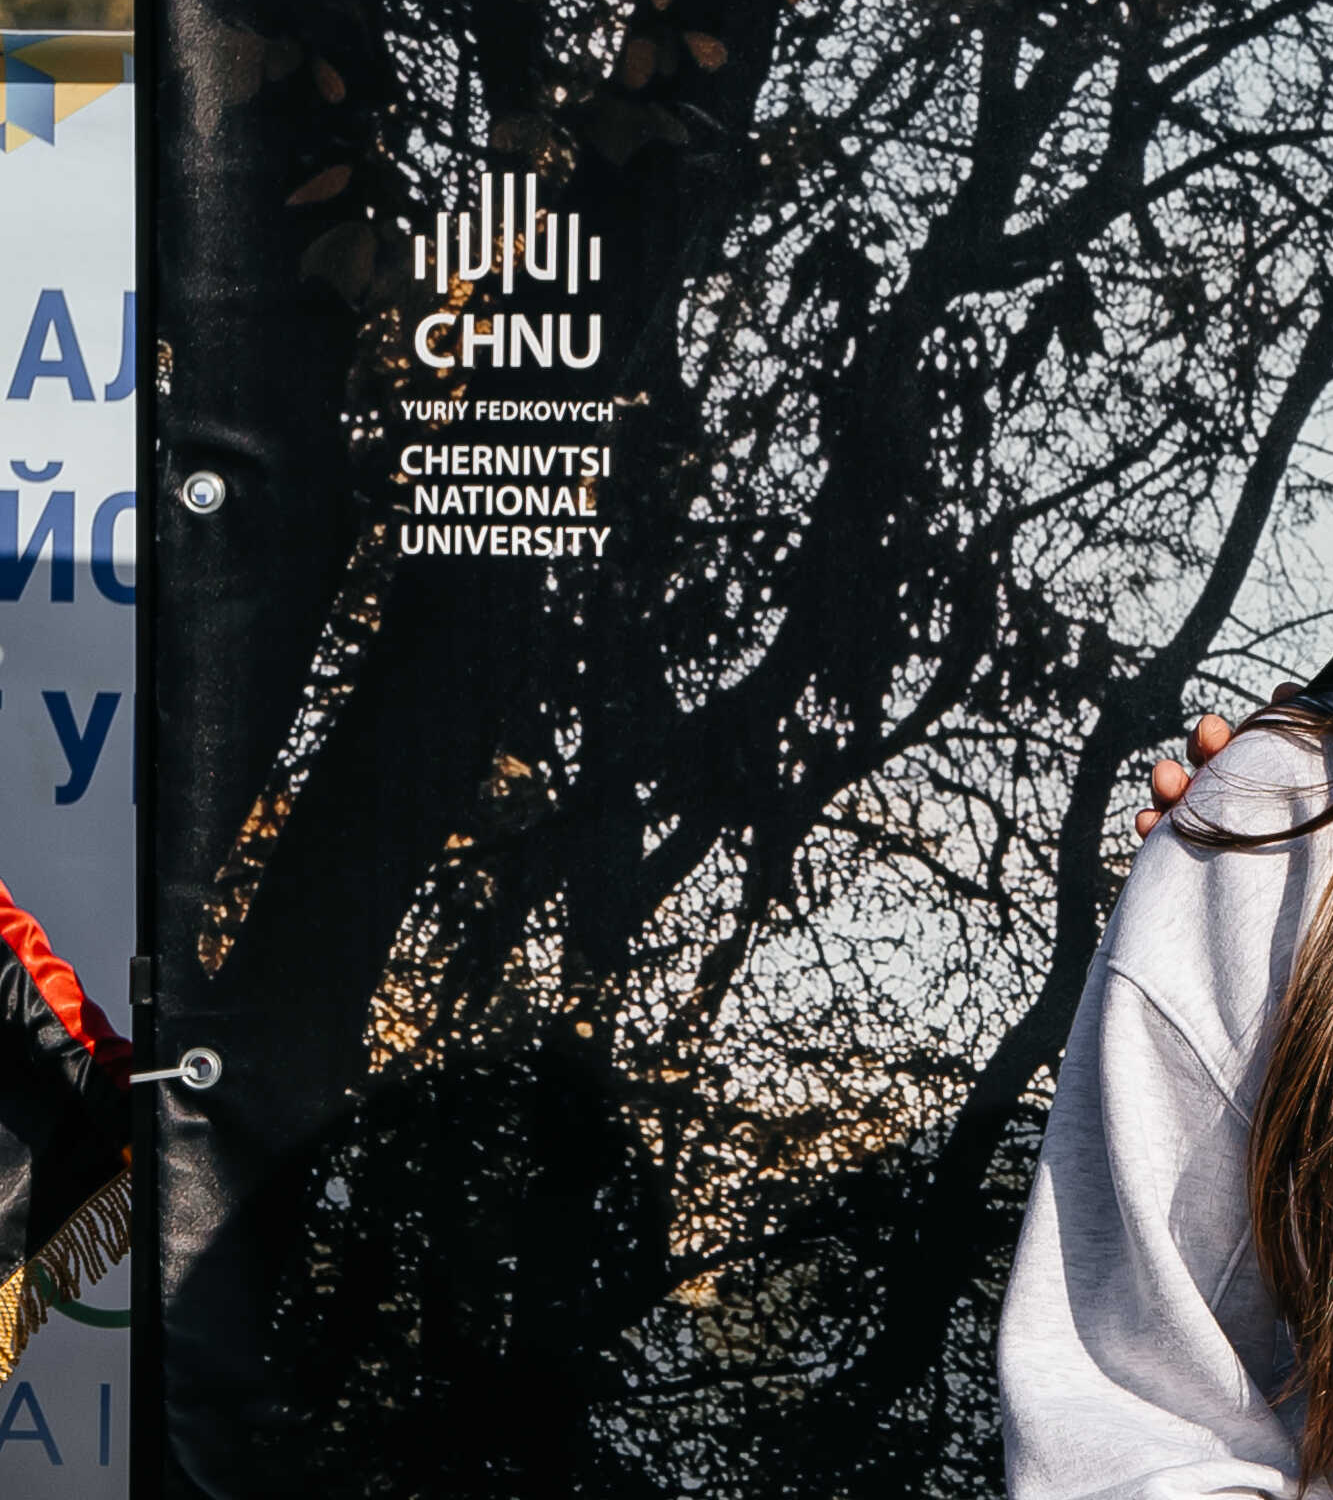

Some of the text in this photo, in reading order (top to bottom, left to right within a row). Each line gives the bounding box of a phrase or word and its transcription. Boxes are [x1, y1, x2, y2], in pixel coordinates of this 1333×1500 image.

[414, 313, 601, 369] CHNU
[400, 400, 614, 423] YURIY FEDKOVYCH
[400, 444, 611, 477] CHERNIVTSI
[413, 484, 597, 517] NATIONAL
[400, 525, 611, 557] UNIVERSITY
